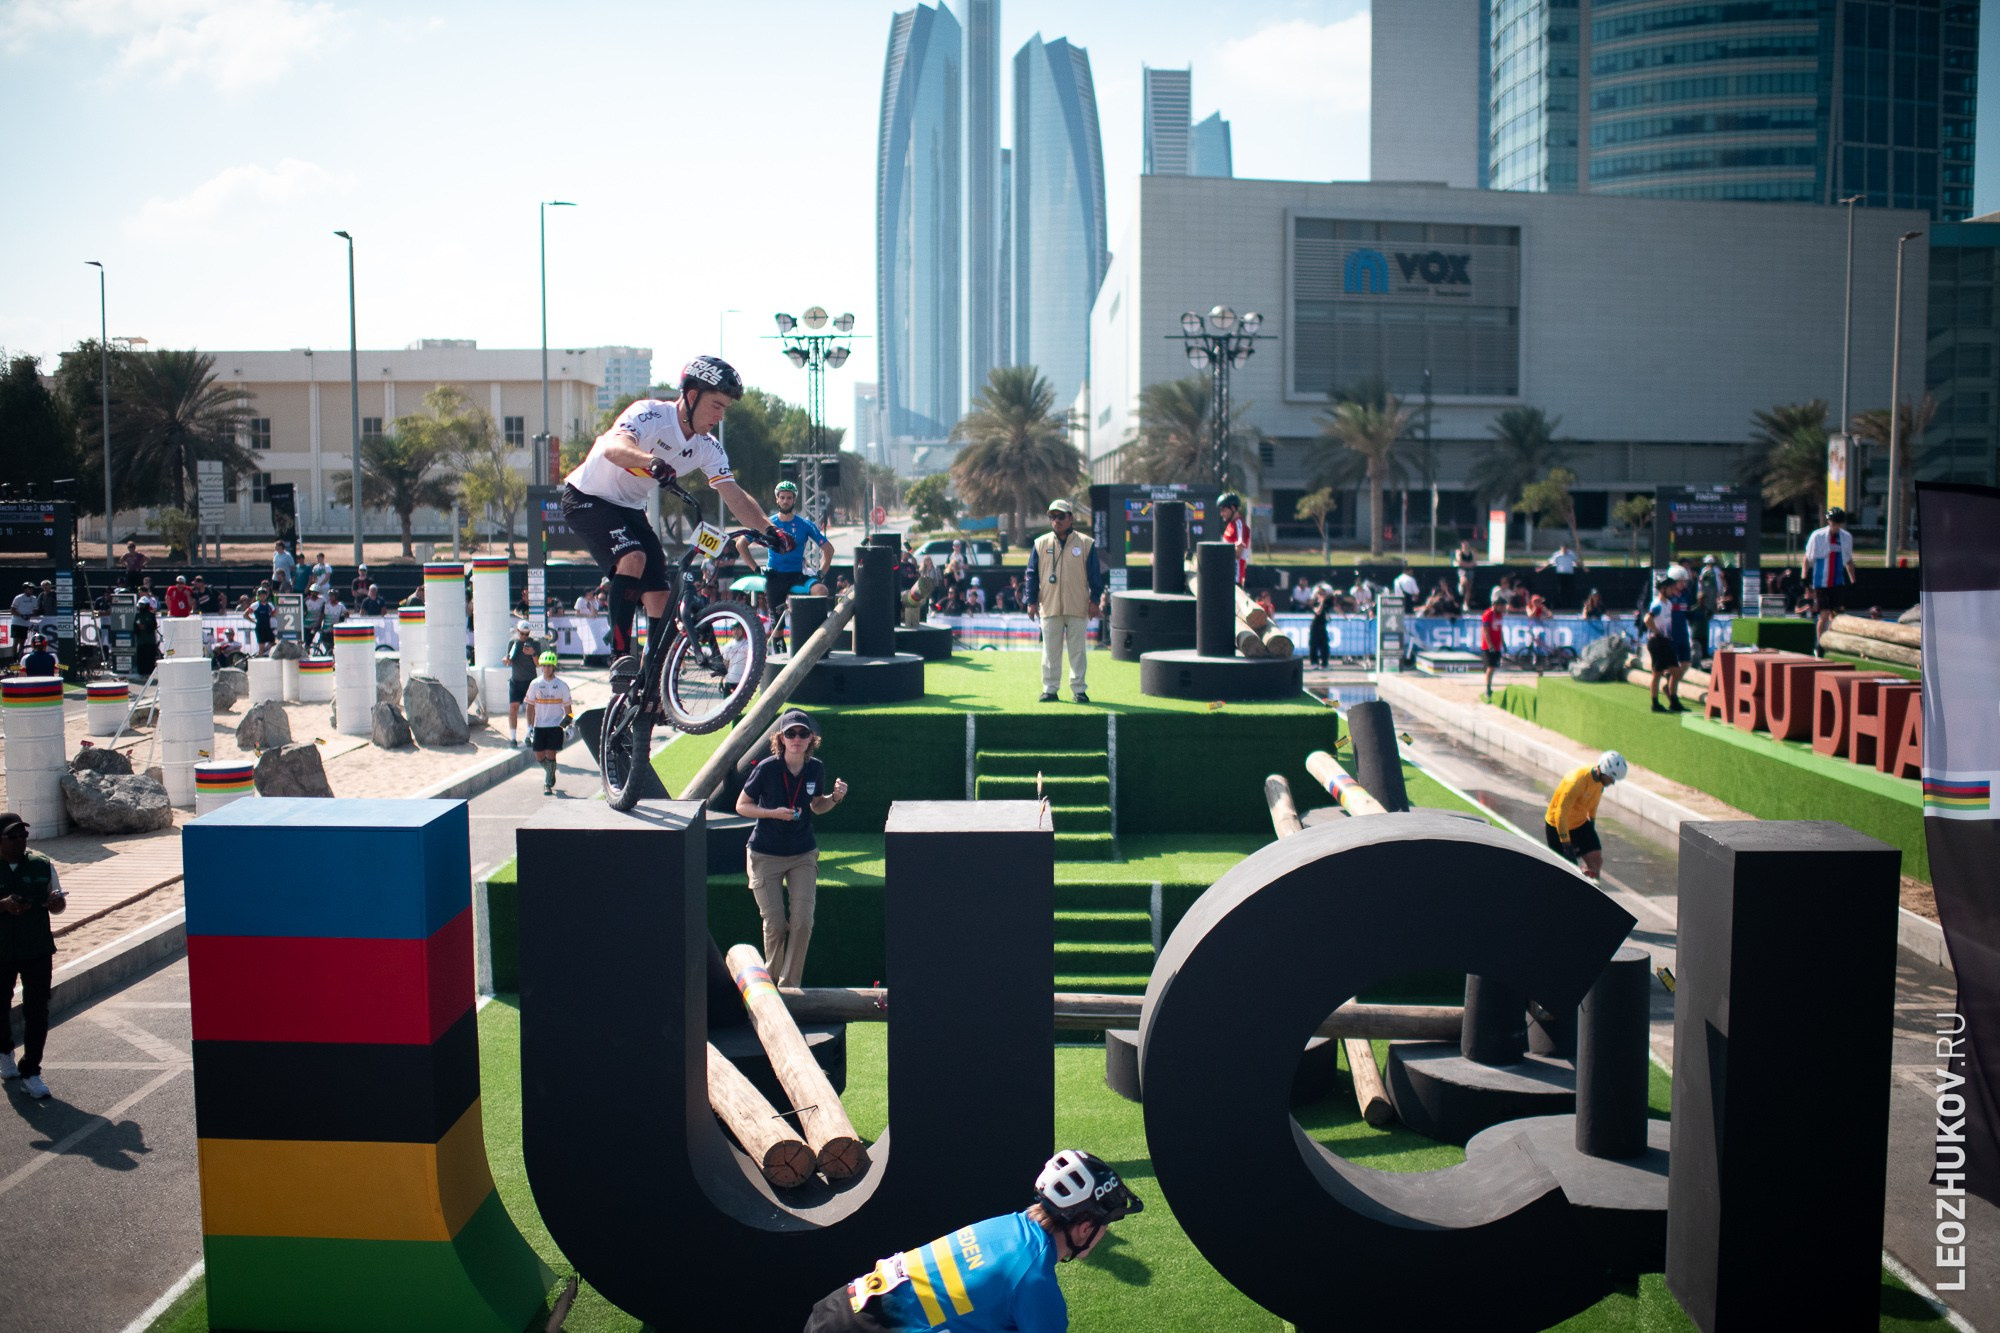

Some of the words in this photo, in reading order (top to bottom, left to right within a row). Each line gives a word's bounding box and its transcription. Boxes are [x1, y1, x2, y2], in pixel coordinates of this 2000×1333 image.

[1395, 250, 1472, 285] VOX
[684, 365, 723, 386] BIKES
[691, 359, 723, 377] TRIAL
[43, 528, 53, 536] 30
[548, 525, 555, 534] 10
[558, 525, 565, 534] 10
[701, 534, 718, 550] 101
[112, 606, 134, 614] FINISH
[278, 606, 299, 614] START
[119, 614, 126, 630] 1
[283, 615, 295, 630] 2
[1385, 615, 1399, 632] 4
[1432, 625, 1573, 648] SHIANO
[1704, 649, 1793, 741] ABU
[517, 805, 1901, 1333] UCI
